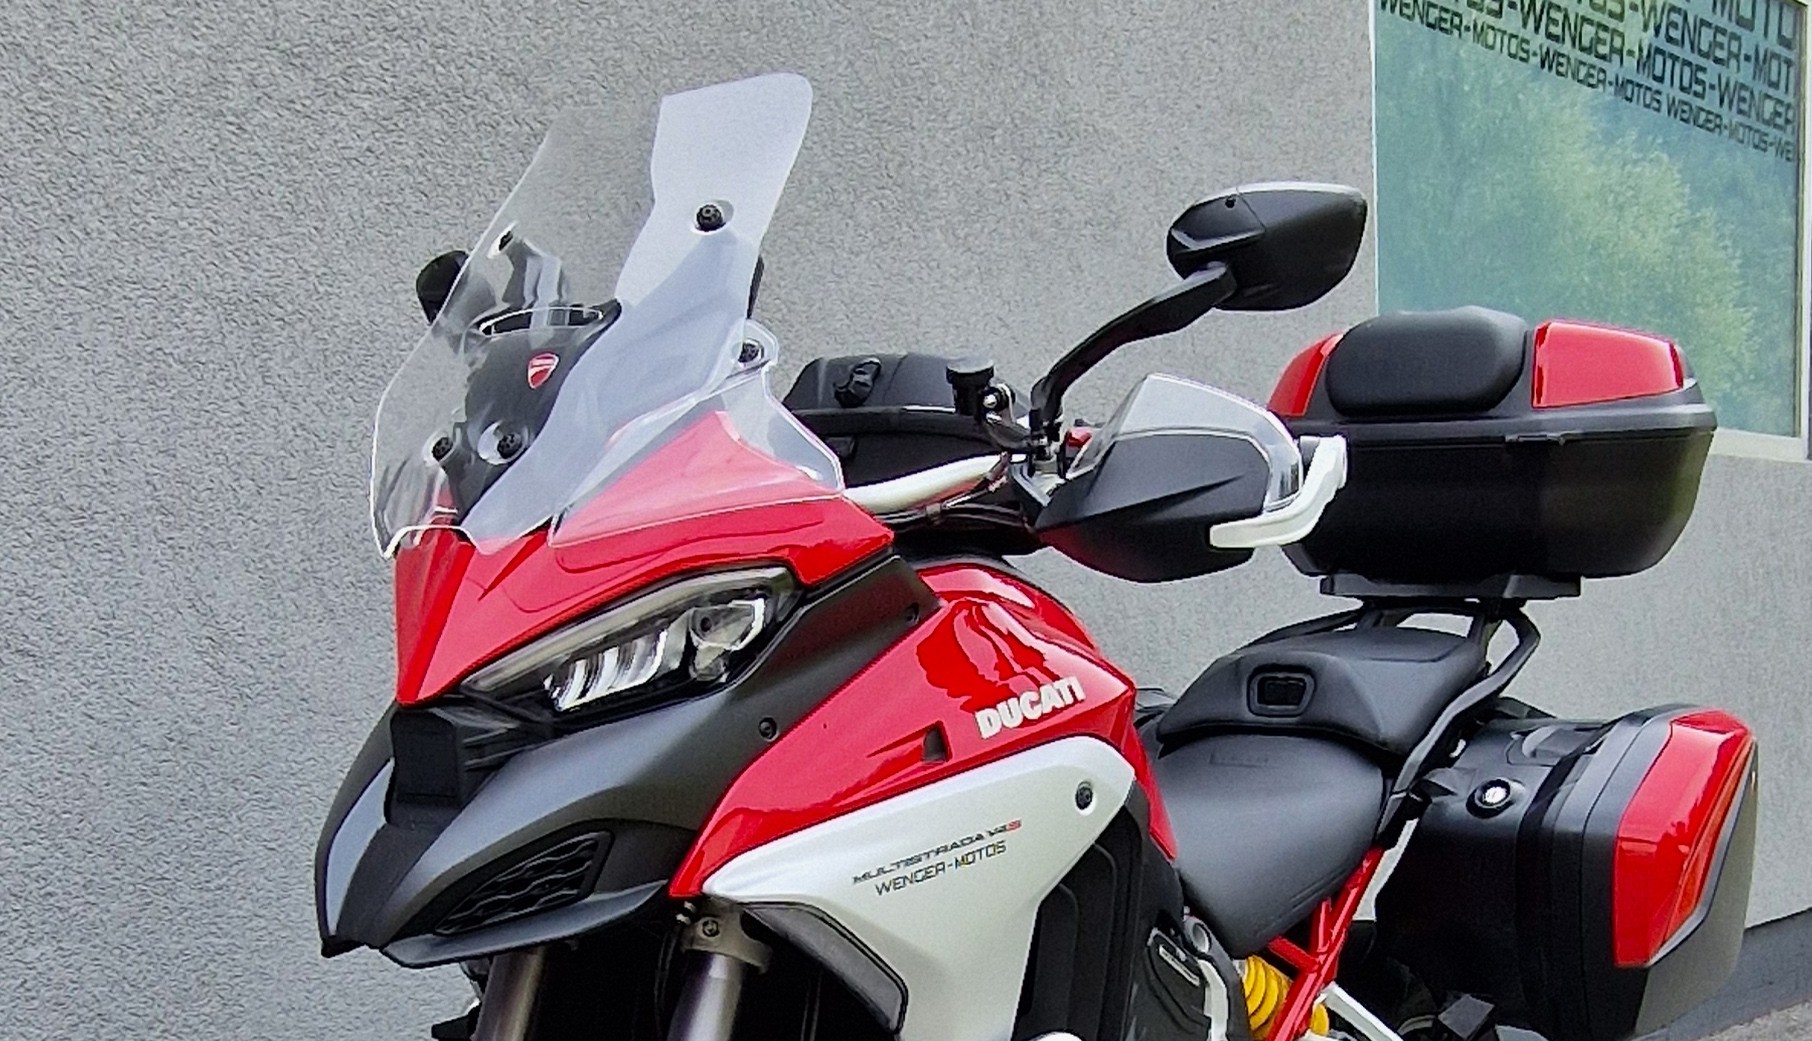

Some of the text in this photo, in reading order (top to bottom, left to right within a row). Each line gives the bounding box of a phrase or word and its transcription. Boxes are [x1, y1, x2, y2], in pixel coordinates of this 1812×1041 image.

[975, 676, 1086, 739] DUCATI
[852, 832, 984, 884] MULTISTRADA
[875, 840, 1007, 896] WENGER-MOTOS
